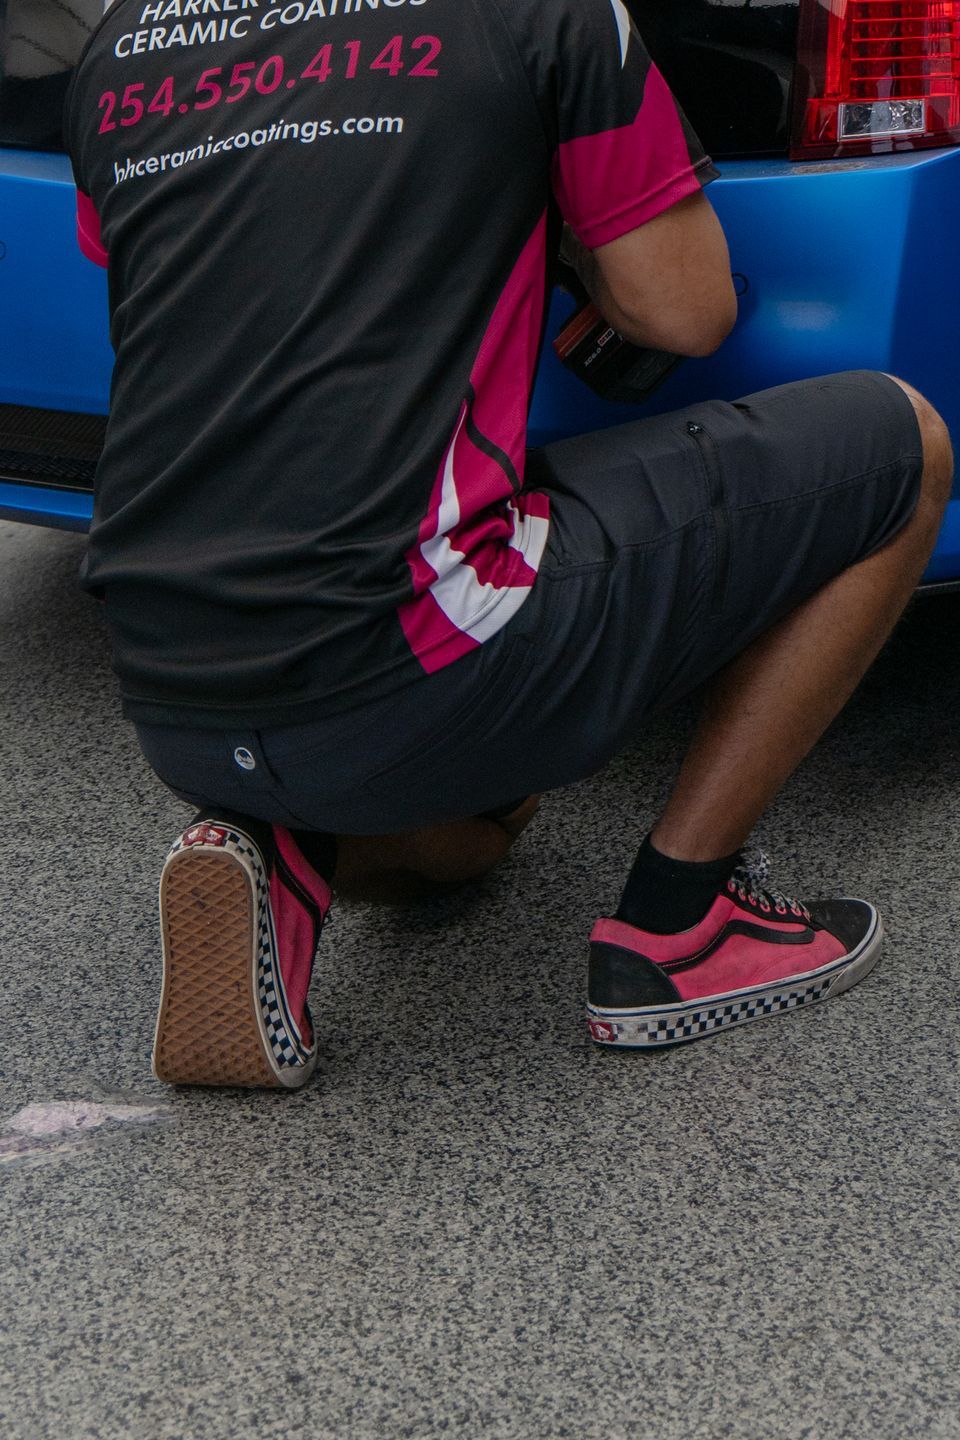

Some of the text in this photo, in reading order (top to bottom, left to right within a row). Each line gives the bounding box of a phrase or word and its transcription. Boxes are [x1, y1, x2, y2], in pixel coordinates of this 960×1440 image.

[114, 15, 252, 59] CERAMIC
[97, 34, 443, 135] 254.550.4142
[113, 113, 404, 185] hhceramiccoatings.com
